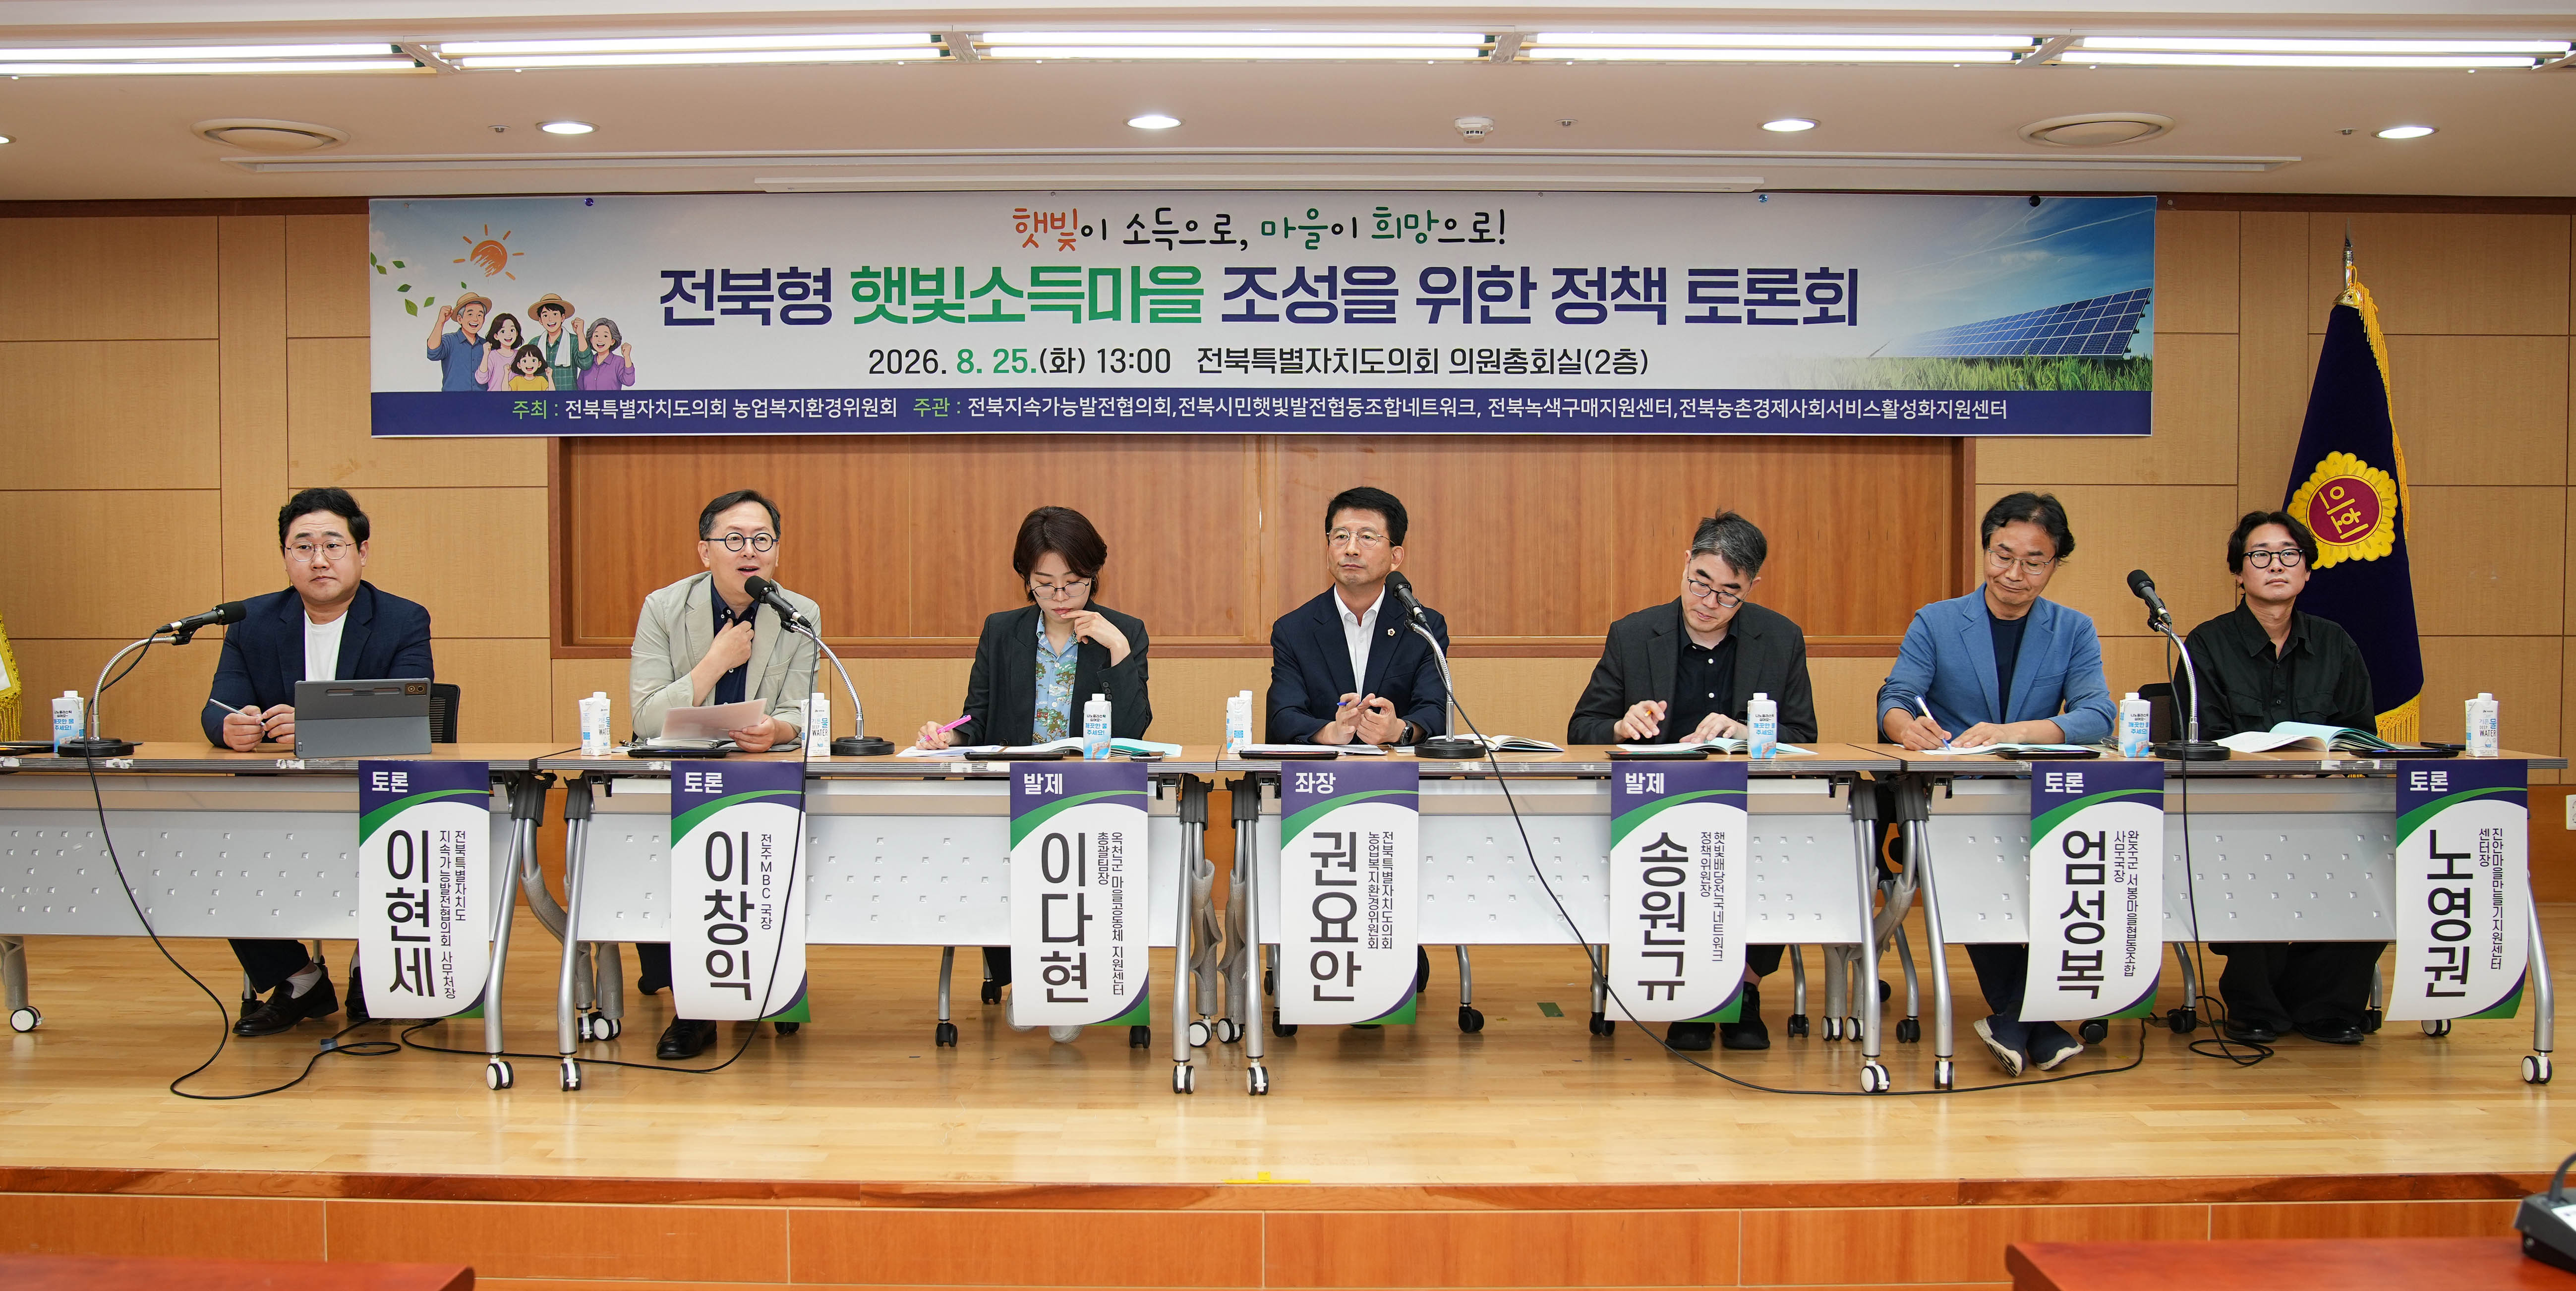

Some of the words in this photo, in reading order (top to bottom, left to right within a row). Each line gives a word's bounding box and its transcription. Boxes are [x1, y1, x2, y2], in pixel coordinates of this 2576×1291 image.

[1012, 207, 1107, 252] 햇빛이
[1122, 207, 1248, 251] 소득으로,
[1261, 208, 1357, 250] 마을이
[1371, 206, 1505, 245] 희망으로!
[660, 266, 832, 326] 전북형
[850, 265, 1204, 325] 햇빛소득마을
[1221, 265, 1399, 324] 조성을
[1416, 264, 1537, 324] 위한
[1551, 265, 1667, 325] 정책
[1685, 266, 1858, 326] 토론회
[869, 349, 946, 374] 2026.
[956, 349, 982, 374] 8.
[993, 347, 1085, 374] 25.(화)
[1097, 348, 1171, 374] 13:00
[1197, 348, 1438, 374] 전북특별자치도의회
[1449, 348, 1648, 375] 의원총회실(2층)
[512, 400, 547, 420] 주최
[565, 398, 726, 419] 전북특별자치도의회
[732, 397, 896, 419] 농업복지환경위원회
[913, 397, 950, 417] 주관
[2318, 485, 2369, 540] 의회
[372, 771, 409, 793] 토론
[684, 772, 723, 794] 토론
[1024, 773, 1062, 795] 발제
[1295, 772, 1336, 794] 좌장
[1626, 773, 1664, 794] 발제
[2045, 772, 2084, 793] 토론
[2410, 771, 2448, 792] 토론
[761, 834, 772, 899] 전주MBC
[1097, 831, 1110, 885] 총괄팀장
[1111, 832, 1123, 872] 옥천군
[1699, 831, 1712, 897] 정책위원장
[2113, 830, 2126, 883] 사무국장
[2127, 830, 2140, 870] 완주군
[2478, 828, 2491, 867] 센터장
[439, 830, 452, 947] 지속가능발전협의회
[455, 830, 467, 921] 전북특별자치도
[1367, 831, 1380, 950] 농업복지환경위원회
[1381, 831, 1395, 950] 전북특별자치도의회
[1711, 831, 1726, 962] 햇빛배당전국네트워크
[2488, 828, 2504, 970] 진안마을만들기지원센터
[385, 829, 436, 998] 이현세
[703, 831, 755, 1001] 이창익
[761, 904, 773, 930] 국장
[1040, 832, 1093, 1003] 이다현
[1112, 876, 1124, 942] 마을공동체
[1310, 831, 1362, 1002] 권요안
[1637, 832, 1689, 1001] 송원규
[2056, 830, 2106, 999] 엄성복
[2122, 872, 2139, 977] 서봉마을협동조합
[2424, 829, 2473, 998] 노영권
[441, 951, 456, 999] 사무처장
[1112, 946, 1124, 996] 지원센터
